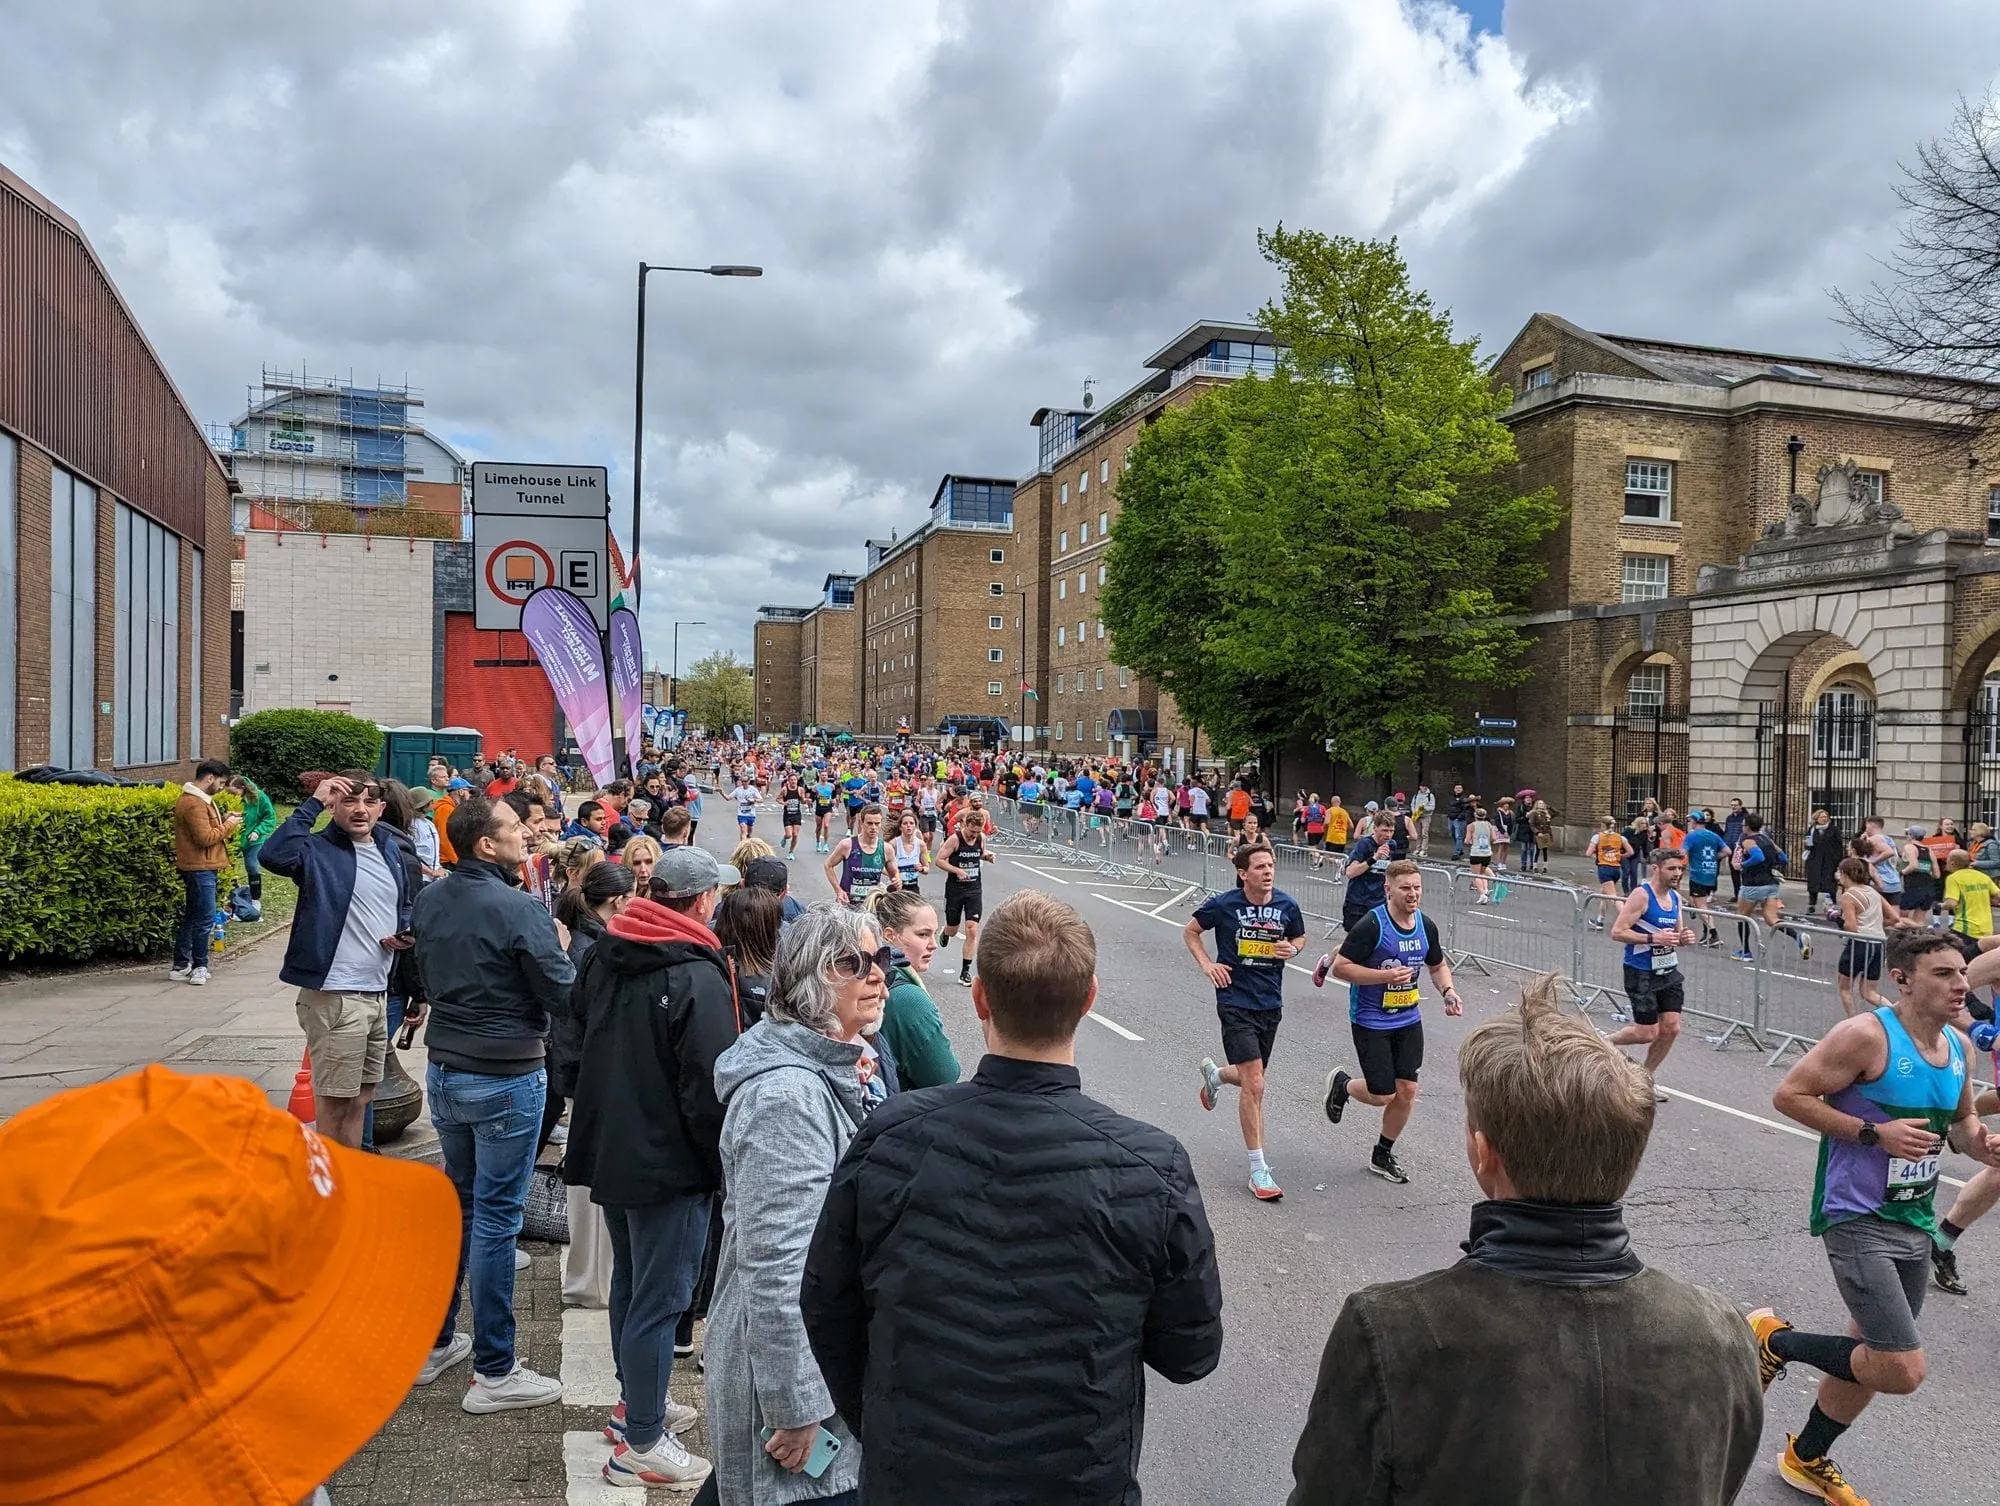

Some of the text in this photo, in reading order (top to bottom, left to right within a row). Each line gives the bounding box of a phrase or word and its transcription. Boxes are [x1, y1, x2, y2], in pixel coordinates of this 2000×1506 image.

[484, 472, 597, 488] Limehouse Link
[516, 491, 565, 505] Tunnel
[569, 560, 589, 588] E
[1777, 564, 1819, 581] TRADE
[1824, 556, 1881, 573] WHARF
[1235, 906, 1282, 921] LEIGH
[1242, 927, 1257, 939] tcs
[1248, 944, 1271, 955] 2748
[1399, 939, 1421, 952] RICH
